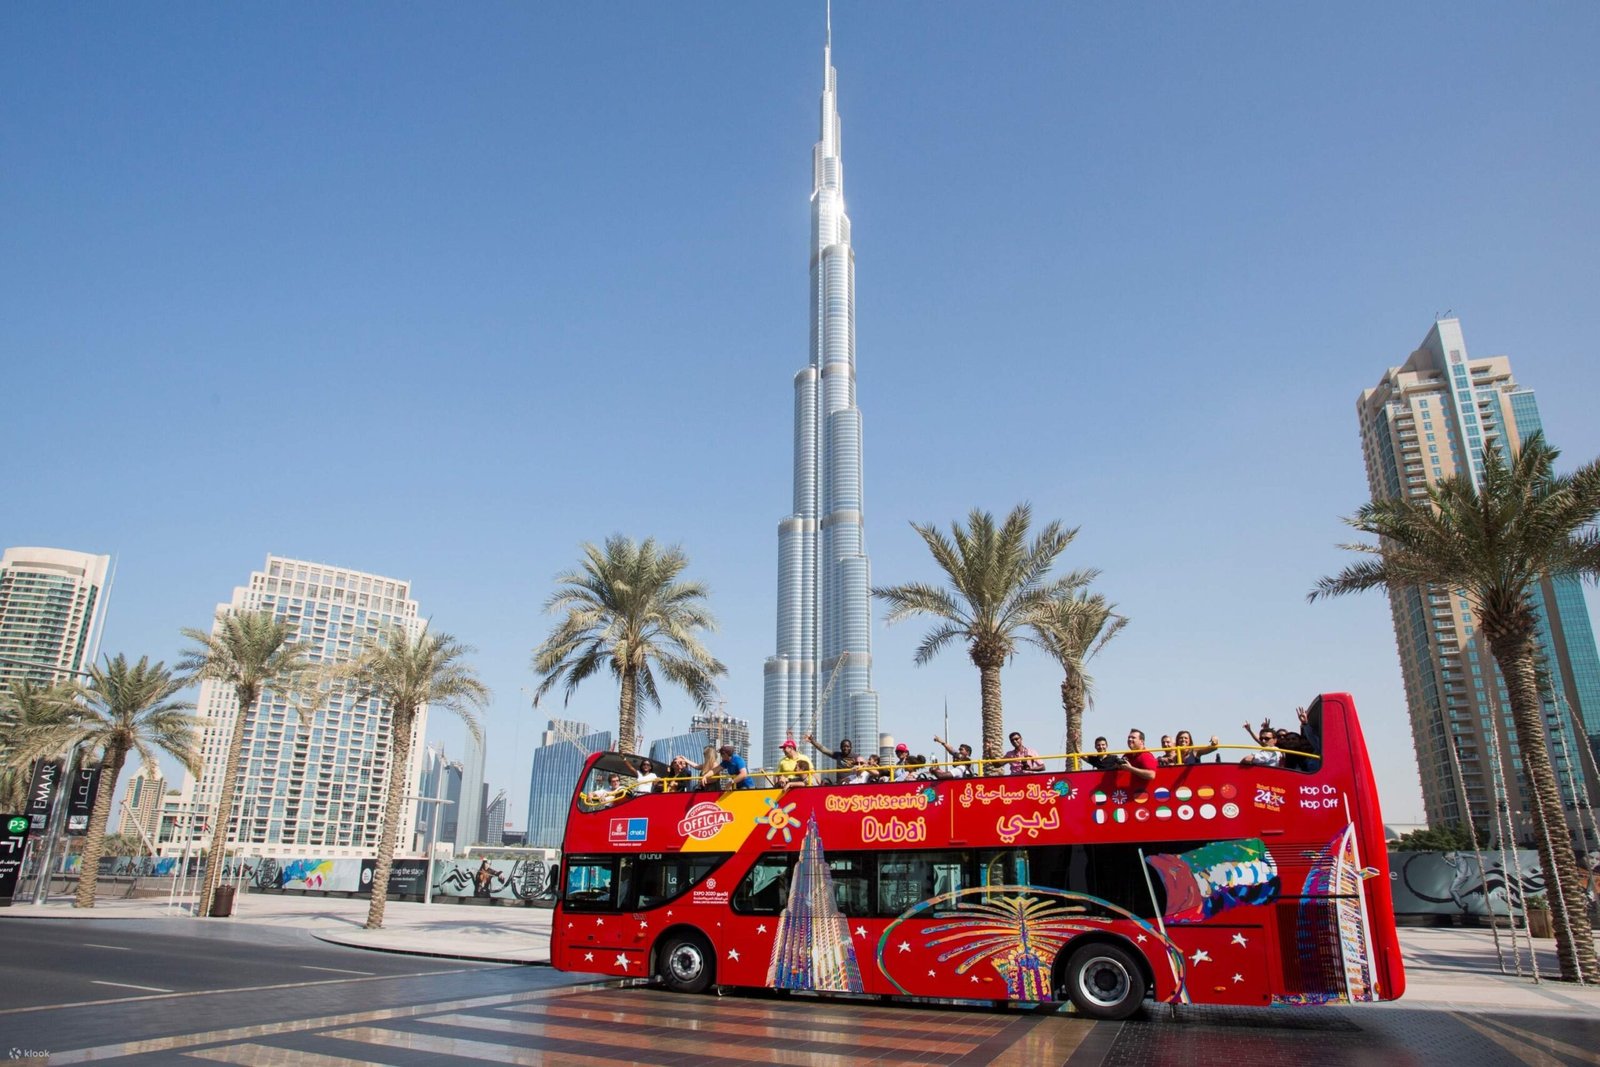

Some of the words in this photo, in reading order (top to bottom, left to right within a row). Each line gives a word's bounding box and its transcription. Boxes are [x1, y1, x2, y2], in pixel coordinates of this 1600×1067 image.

[33, 764, 57, 809] EMAAR
[959, 782, 974, 808] في
[975, 784, 1025, 805] سياحية
[1026, 783, 1061, 805] جولة
[1300, 785, 1320, 796] Hop
[1321, 784, 1336, 794] On
[1300, 799, 1320, 810] Hop
[1322, 798, 1339, 808] Off
[9, 820, 25, 830] P3
[683, 813, 731, 832] OFFICIAL
[697, 825, 719, 838] TOUR
[862, 815, 927, 843] Dubai
[996, 807, 1060, 843] دبي
